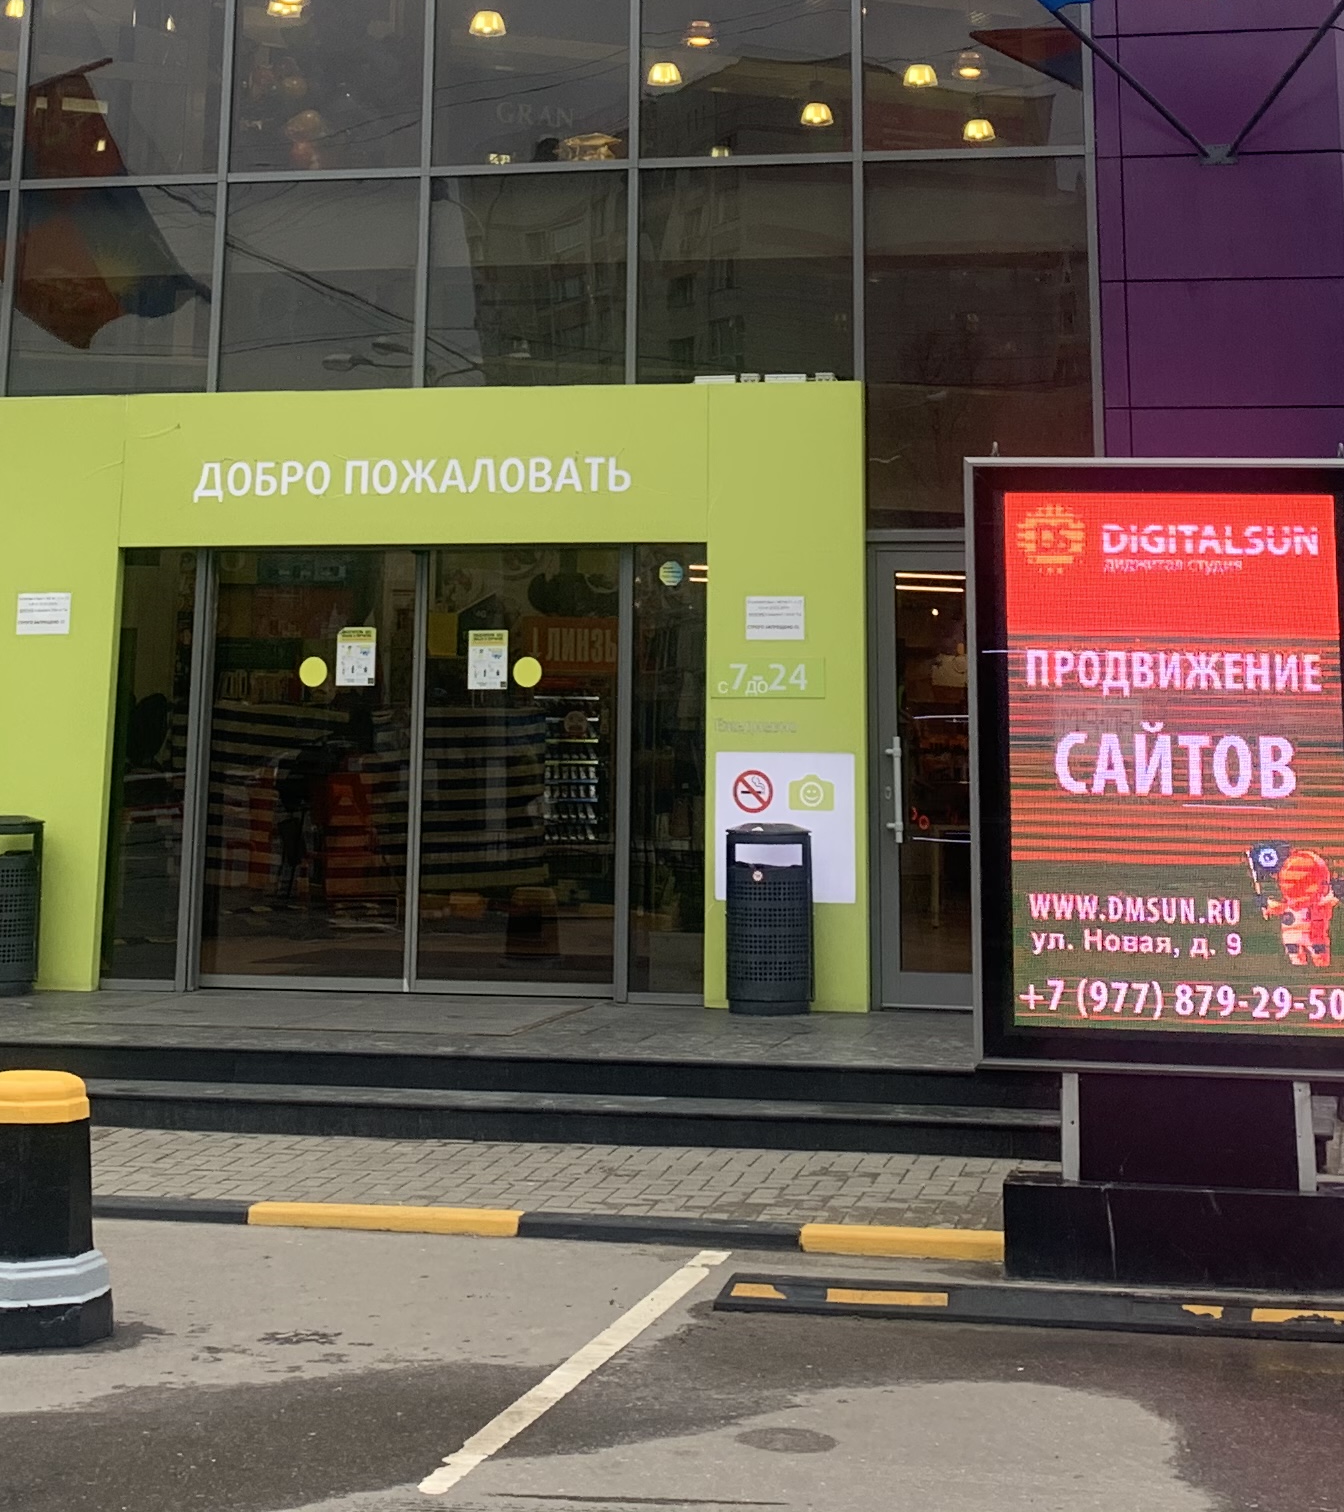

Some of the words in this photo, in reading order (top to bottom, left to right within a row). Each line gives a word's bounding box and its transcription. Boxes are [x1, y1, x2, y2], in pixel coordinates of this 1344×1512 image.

[193, 460, 332, 503] ДОБРО
[344, 457, 633, 494] ПОЖАЛОВАТЬ
[1025, 649, 1323, 698] ПРОДВИЖЕНИЕ
[1054, 721, 1297, 800] САЙТОВ
[1028, 893, 1241, 924] WWW.DMSUN.RU
[1030, 931, 1074, 955] ул.
[1083, 928, 1180, 958] Новая,
[1190, 935, 1216, 959] д.
[1226, 933, 1242, 955] 9
[1019, 979, 1066, 1011] +7
[1077, 978, 1163, 1020] (977)
